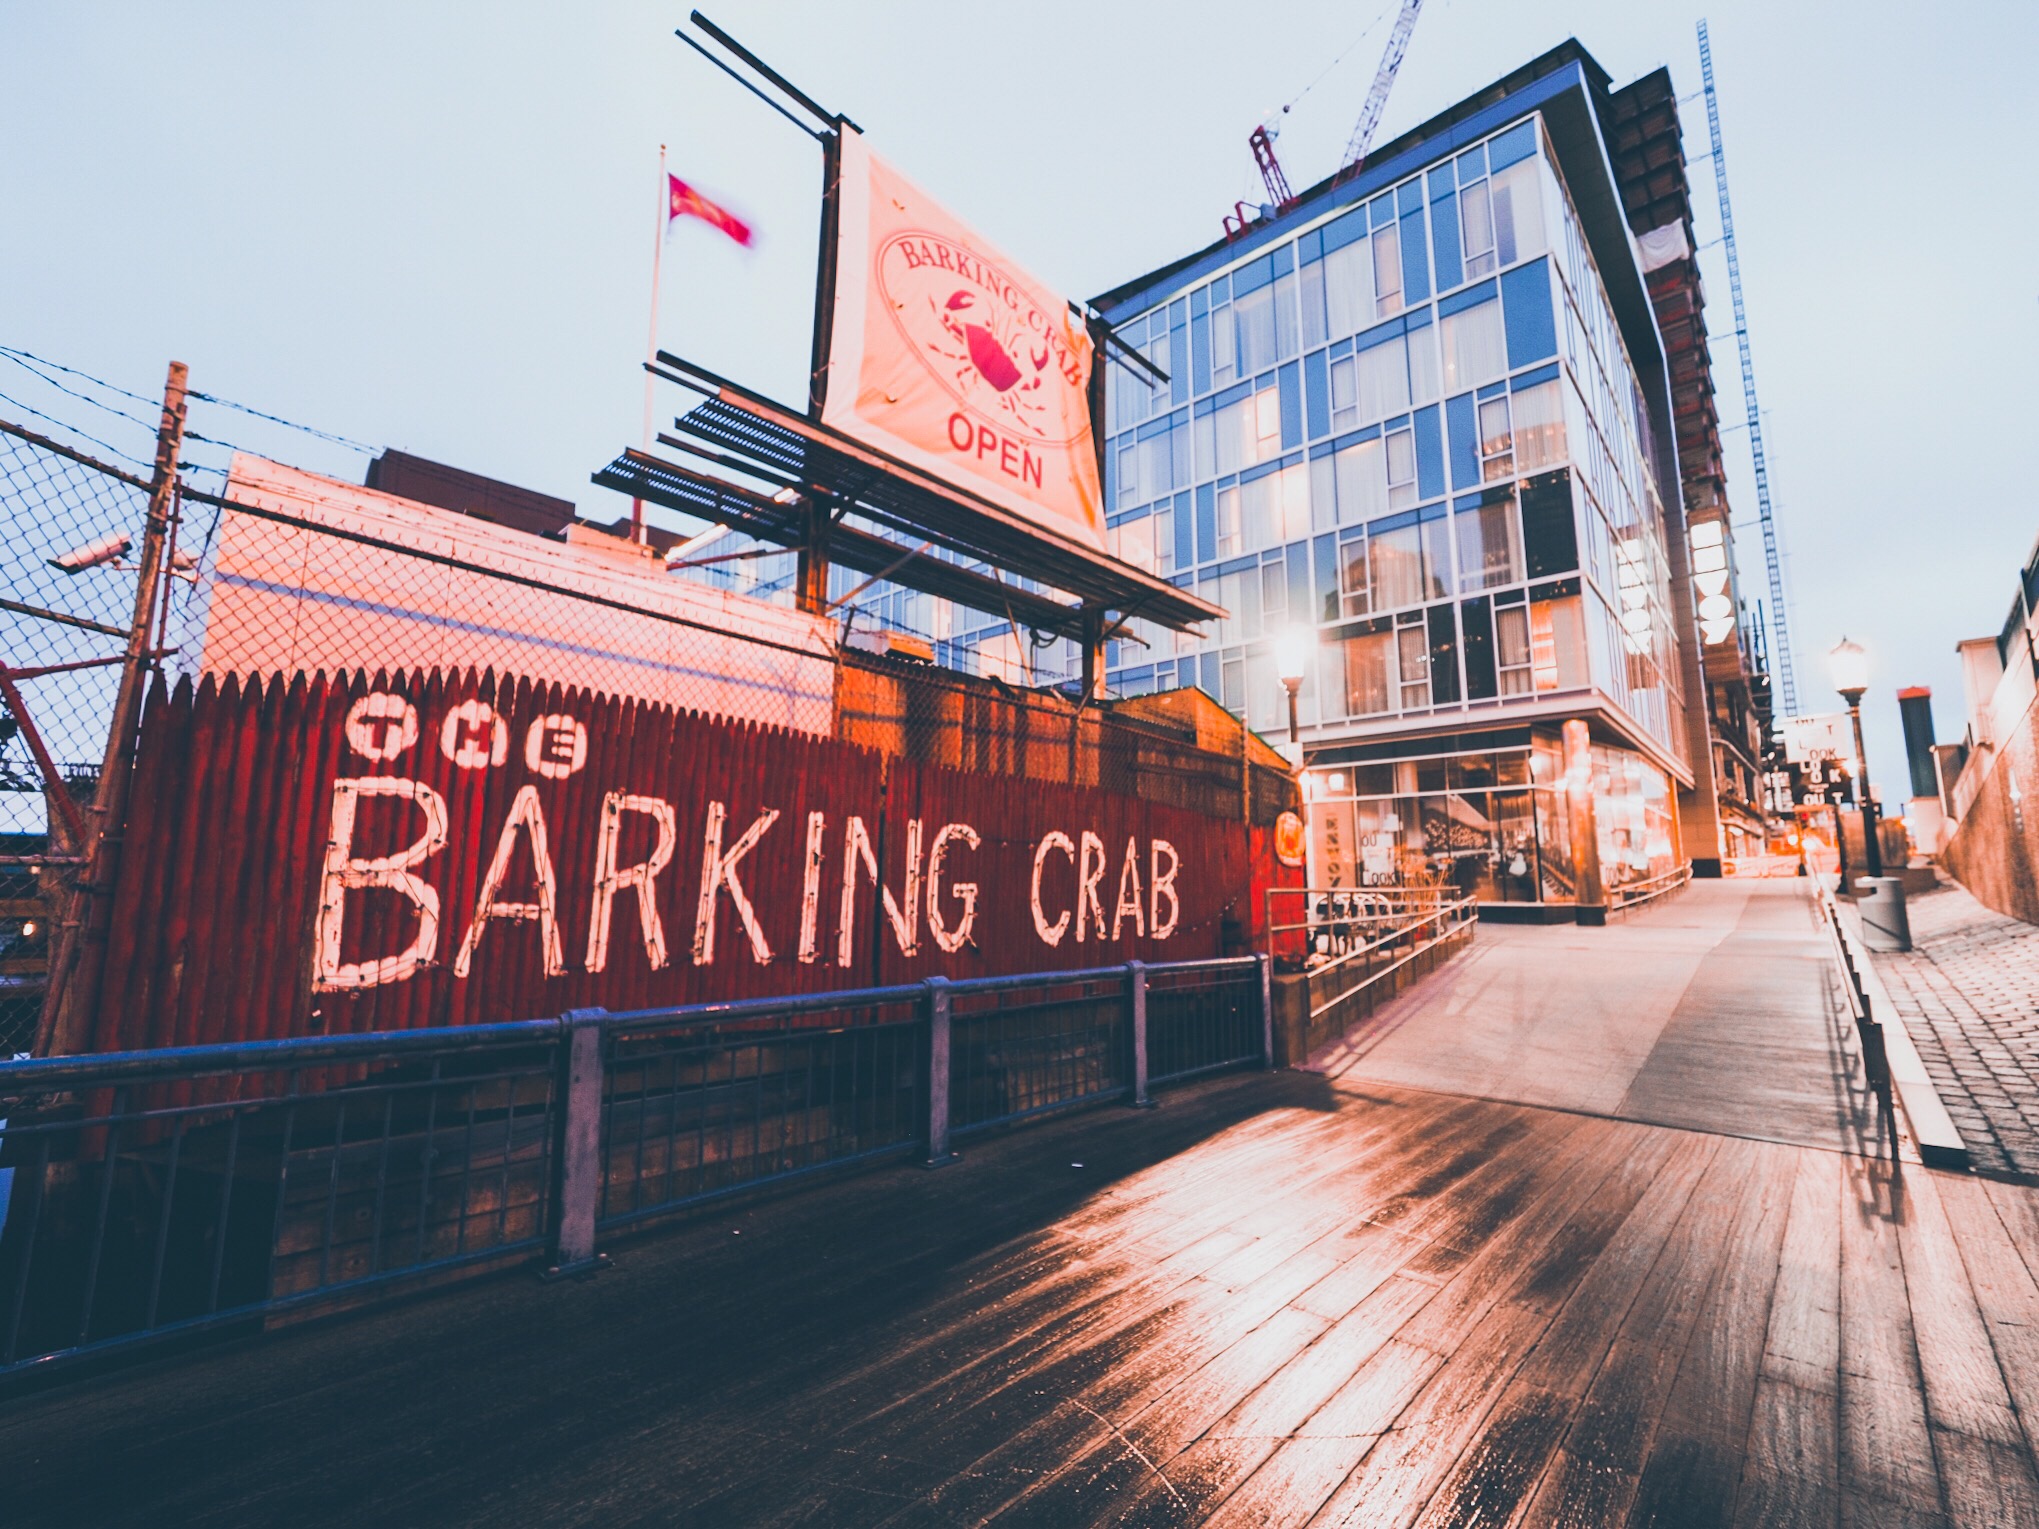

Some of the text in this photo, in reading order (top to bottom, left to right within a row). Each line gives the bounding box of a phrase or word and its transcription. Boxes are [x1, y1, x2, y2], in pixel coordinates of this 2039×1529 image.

[899, 240, 1082, 388] BARKING CRAB
[947, 411, 1043, 489] OPEN
[345, 691, 588, 780] THE
[312, 776, 1180, 994] BARKING CRAB
